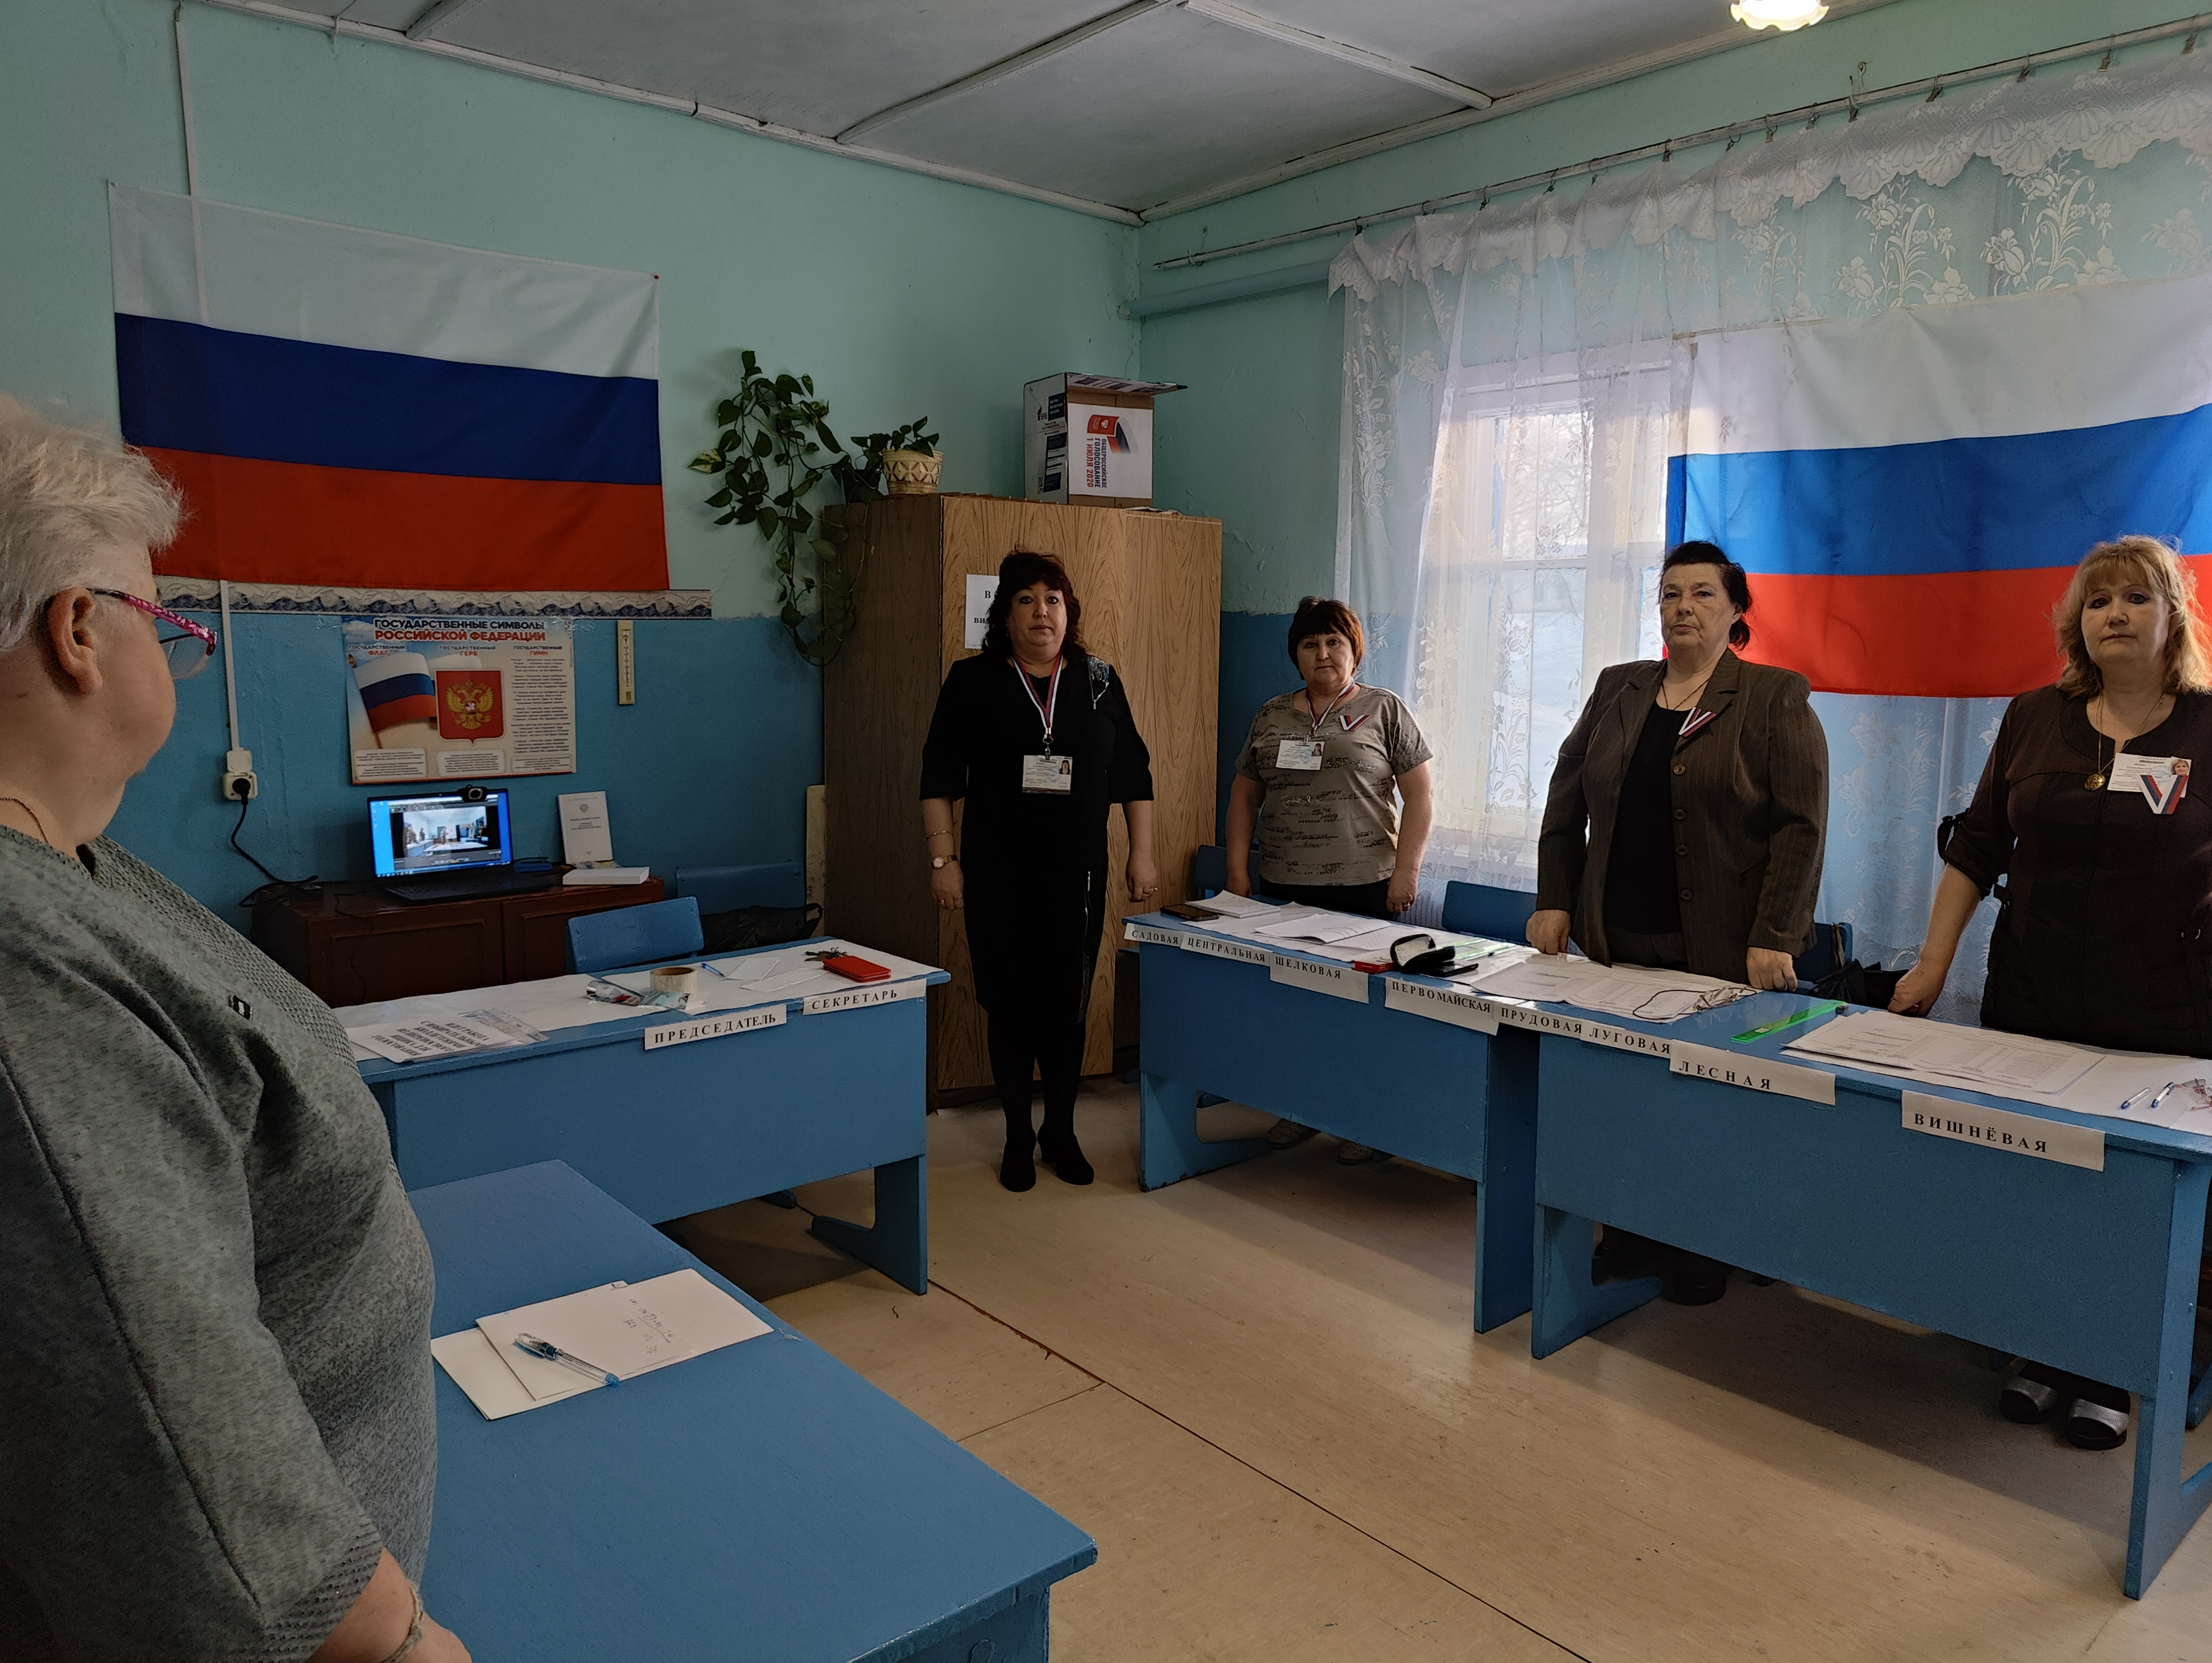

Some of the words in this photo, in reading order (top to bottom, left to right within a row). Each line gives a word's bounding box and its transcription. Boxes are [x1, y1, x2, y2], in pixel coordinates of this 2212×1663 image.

[374, 619, 488, 629] ГОСУДАРСТВЕННЫЕ
[489, 620, 545, 630] СИМВОЛЫ
[375, 629, 467, 641] РОССИЙСКОЙ
[469, 630, 546, 641] ФЕДЕРАЦИИ
[1131, 929, 1179, 945] САДОВАЯ
[1187, 937, 1266, 963] ЦЕНТРАЛЬНАЯ
[1275, 956, 1342, 980] ШЕЛКОВАЯ
[812, 989, 898, 1010] СЕКРЕТАРЬ
[1391, 981, 1491, 1013] ПЕРВОМАЙСКАЯ
[655, 1013, 776, 1044] ПРЕДСЕДАТЕЛЬ
[1501, 1007, 1582, 1034] ПРУДОВАЯ
[1589, 1027, 1671, 1054] ЛУГОВАЯ
[1679, 1060, 1771, 1090] ЛЕСНАЯ
[1914, 1112, 2048, 1153] ВИШНЁВАЯ
